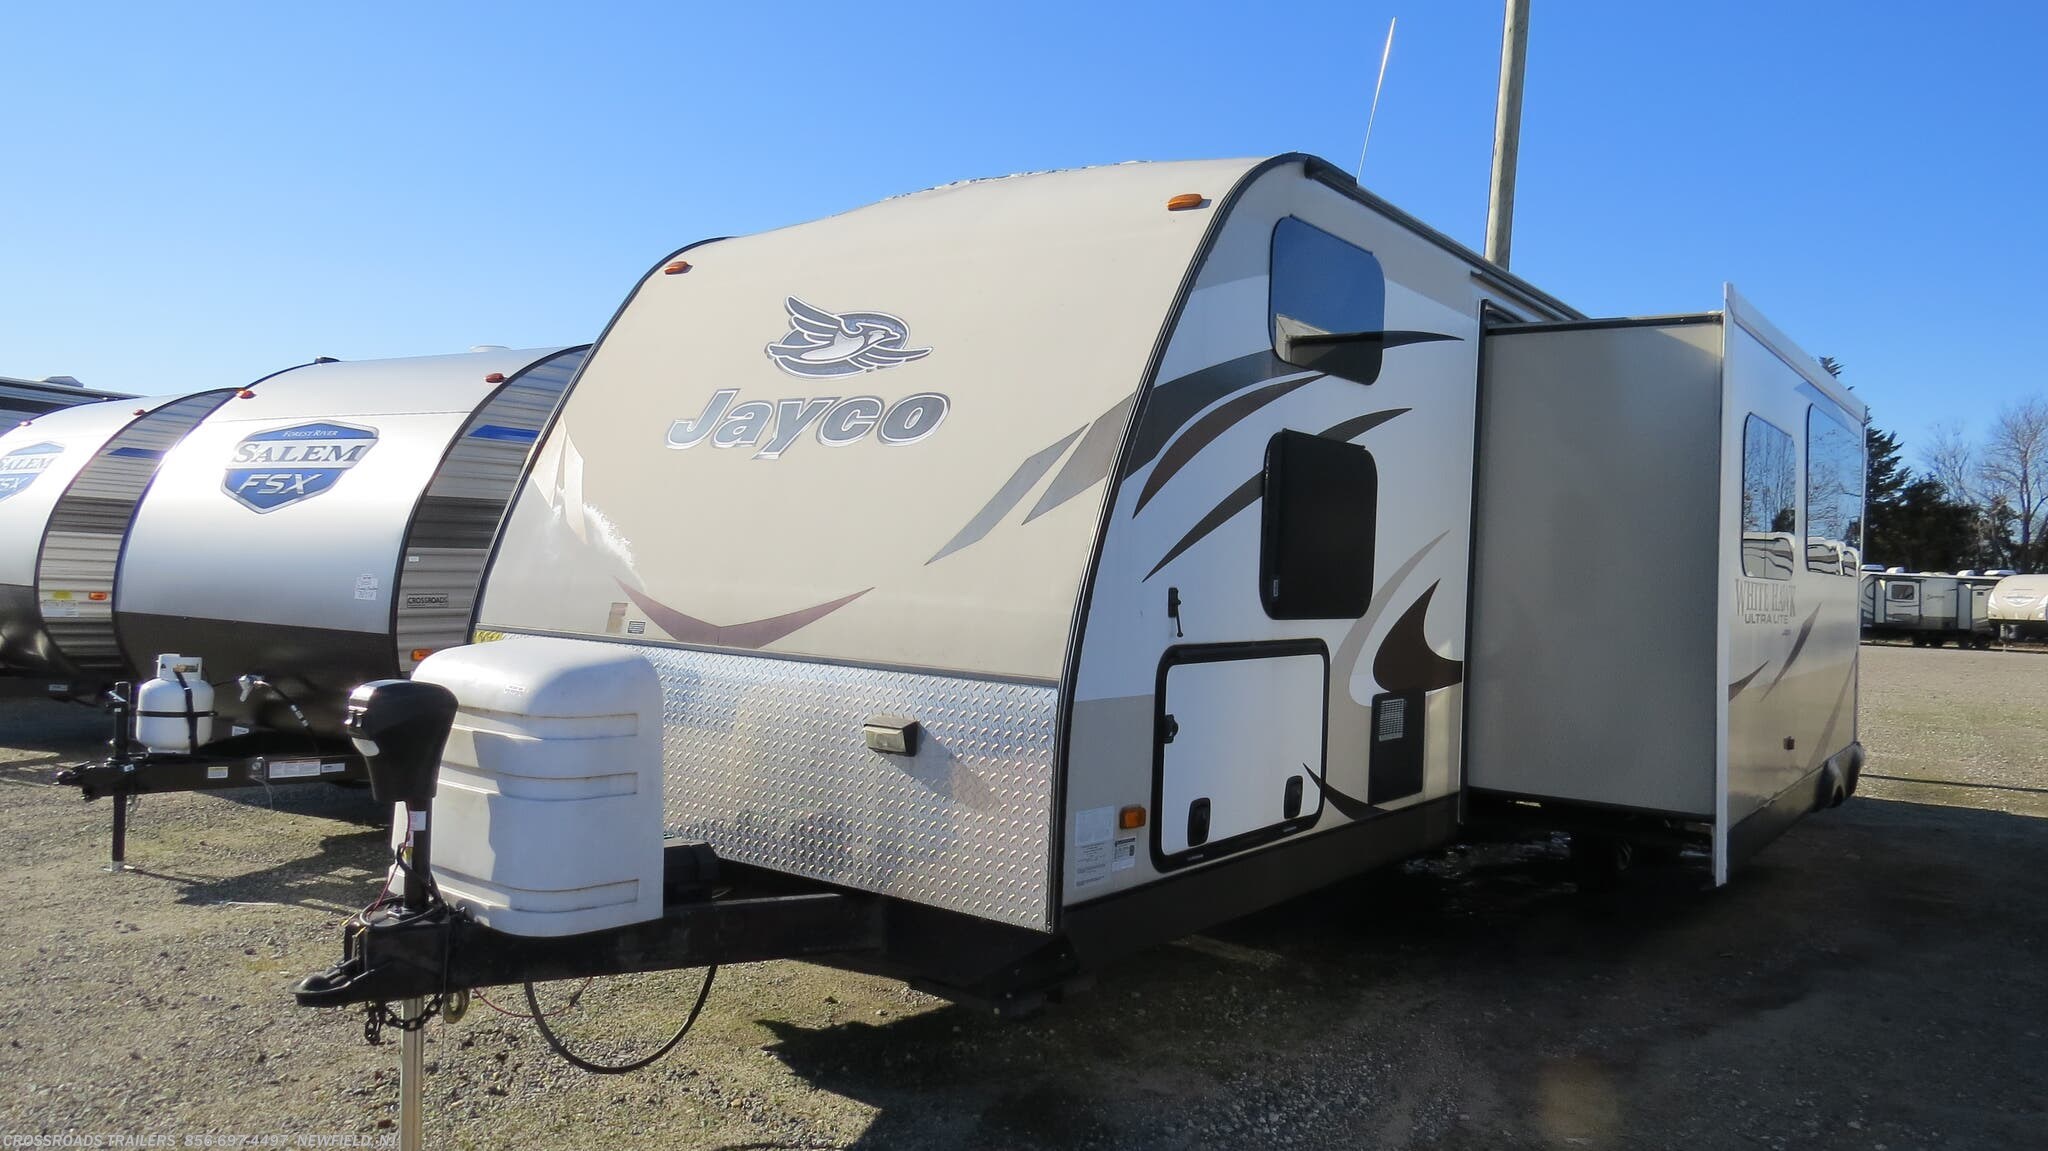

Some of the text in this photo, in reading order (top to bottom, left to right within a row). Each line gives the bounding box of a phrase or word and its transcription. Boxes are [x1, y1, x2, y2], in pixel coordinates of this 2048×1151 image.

[313, 429, 339, 437] RIVER
[664, 388, 951, 460] Jayco
[232, 443, 367, 463] SALEM
[236, 473, 323, 494] FSX
[407, 596, 448, 604] CROSSROADS
[1735, 578, 1796, 617] WHITE HAWK
